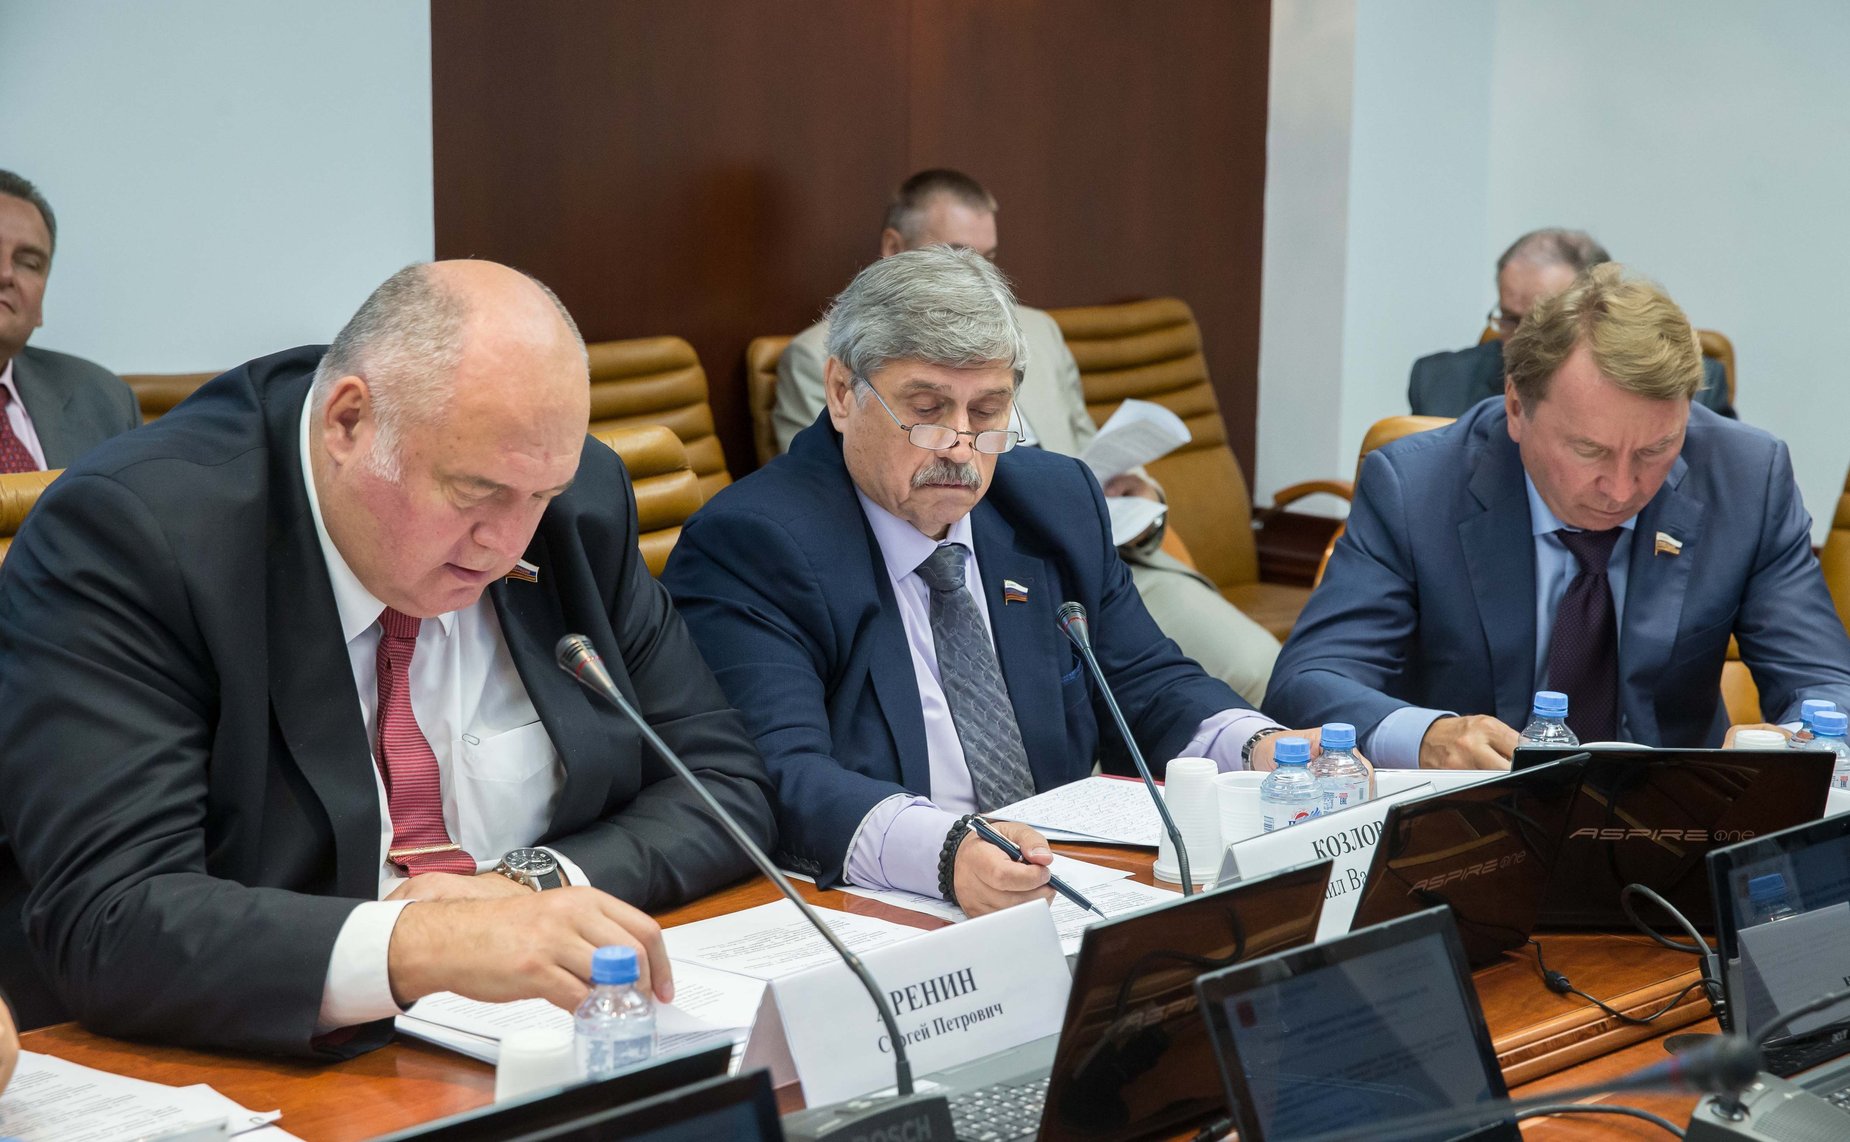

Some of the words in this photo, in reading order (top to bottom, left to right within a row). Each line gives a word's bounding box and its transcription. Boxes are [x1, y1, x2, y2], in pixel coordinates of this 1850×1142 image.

[1569, 827, 1709, 842] ASPIRE
[1407, 859, 1498, 896] ASPIRE
[877, 967, 979, 1023] РЕНИН
[878, 1022, 932, 1054] Сргей
[932, 1003, 1004, 1036] Петрович
[852, 1114, 932, 1142] OSCH
